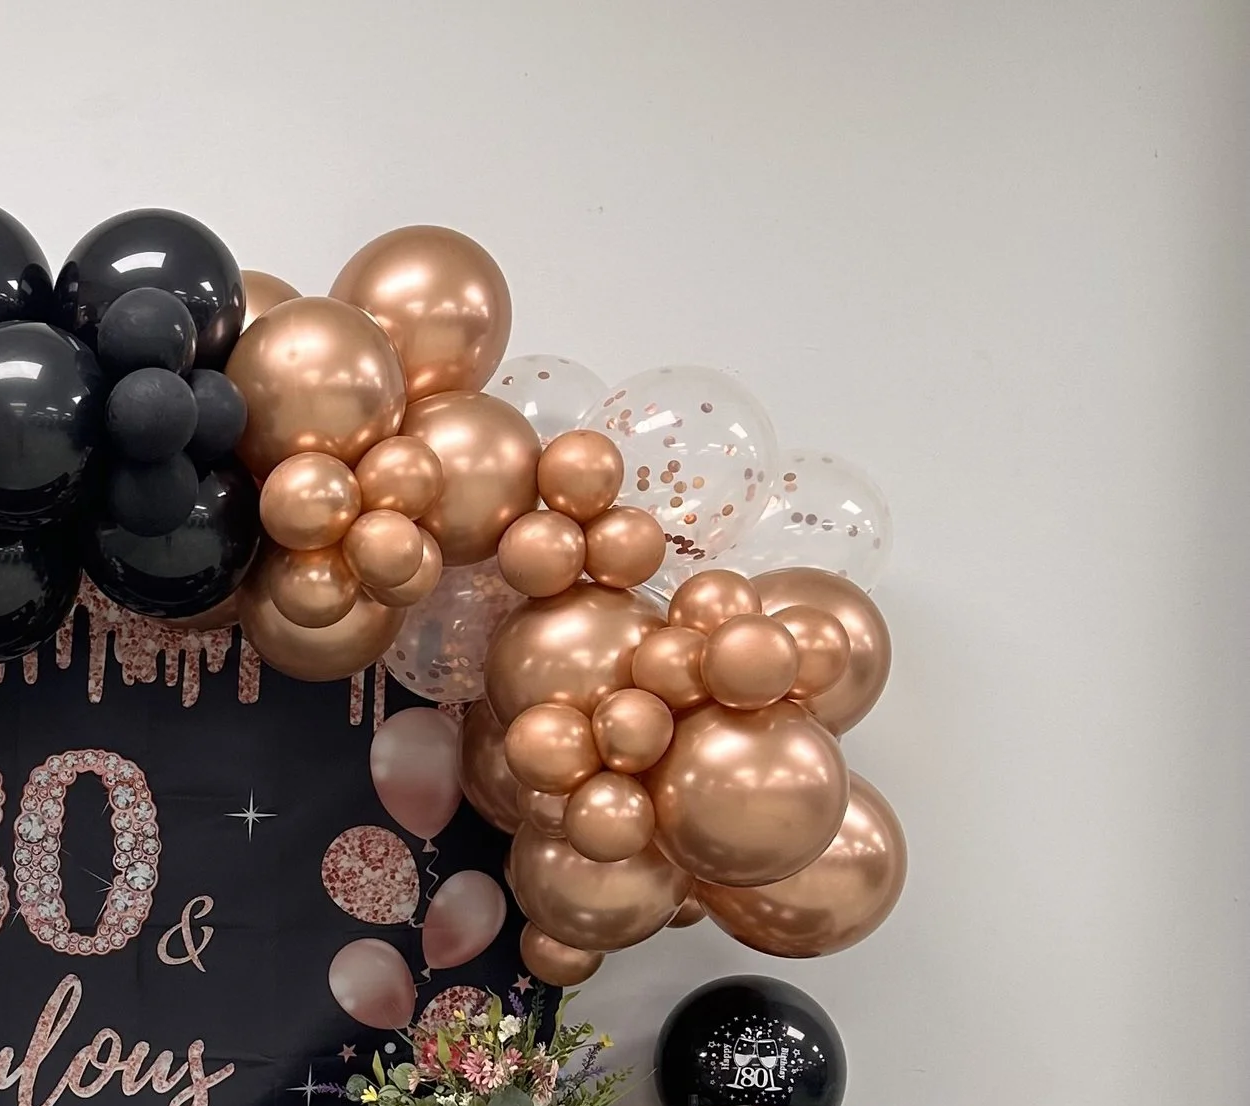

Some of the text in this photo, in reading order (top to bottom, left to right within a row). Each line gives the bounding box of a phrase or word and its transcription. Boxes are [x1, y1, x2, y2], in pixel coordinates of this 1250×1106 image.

[156, 895, 215, 973] &
[719, 1043, 732, 1070] Happy
[777, 1047, 789, 1080] Birthday
[740, 1067, 769, 1088] 80
